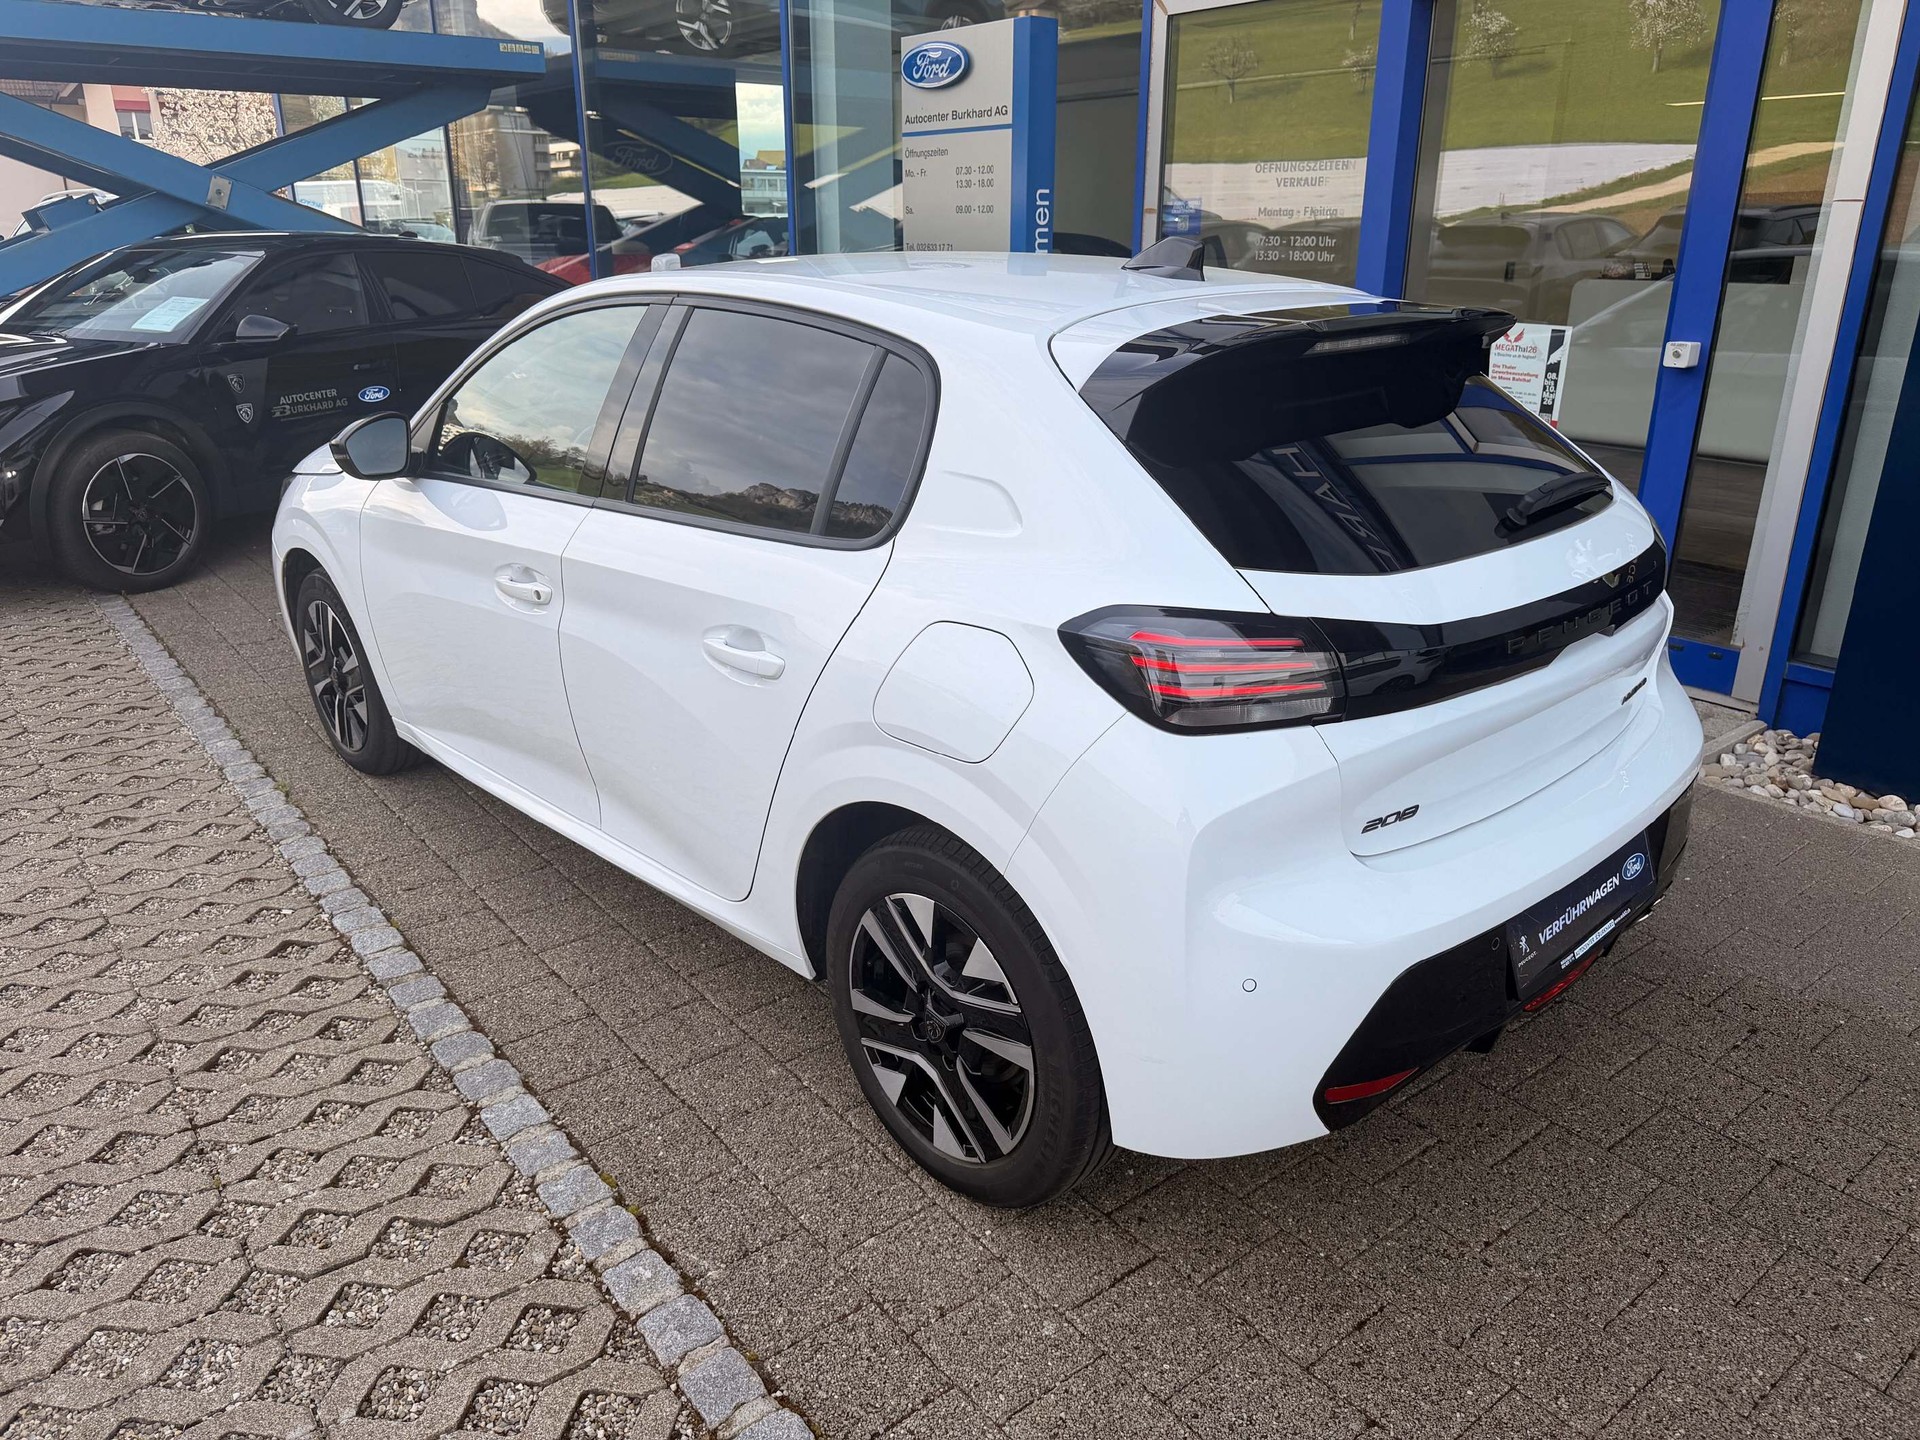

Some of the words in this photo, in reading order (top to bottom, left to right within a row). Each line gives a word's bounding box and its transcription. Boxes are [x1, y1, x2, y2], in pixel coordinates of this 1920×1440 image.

[913, 50, 952, 79] Ford
[905, 112, 949, 125] Autocenter
[951, 106, 992, 120] Burkhard
[994, 105, 1008, 116] AG
[612, 145, 659, 170] Ford
[904, 147, 948, 160] Öffnungszeiten
[905, 169, 915, 177] Mo.
[955, 166, 972, 176] 07.30
[978, 165, 995, 175] 12.00
[956, 179, 972, 189] 13.30
[978, 178, 995, 188] 18.00
[905, 205, 914, 215] Sa.
[955, 205, 972, 214] 09.00
[977, 204, 994, 214] 12.00
[1257, 207, 1294, 219] Montag
[1290, 235, 1317, 247] 12:00
[1318, 235, 1337, 247] Uhr
[1255, 250, 1279, 261] 13:30
[1288, 250, 1315, 261] 18:00
[1317, 250, 1335, 262] Uhr
[1494, 344, 1538, 354] MEGAThal26
[1546, 372, 1558, 380] 08.
[1545, 385, 1556, 393] 10.
[280, 389, 338, 405] AUTOCENTER
[364, 388, 384, 400] Ford
[1543, 391, 1556, 400] Mai
[271, 401, 334, 417] BURKHARD
[335, 398, 348, 408] AG
[1543, 398, 1553, 406] 26
[1507, 581, 1652, 655] PEUGEOT
[1361, 804, 1420, 834] 208
[1538, 873, 1620, 945] VERFÜHRWAGEN
